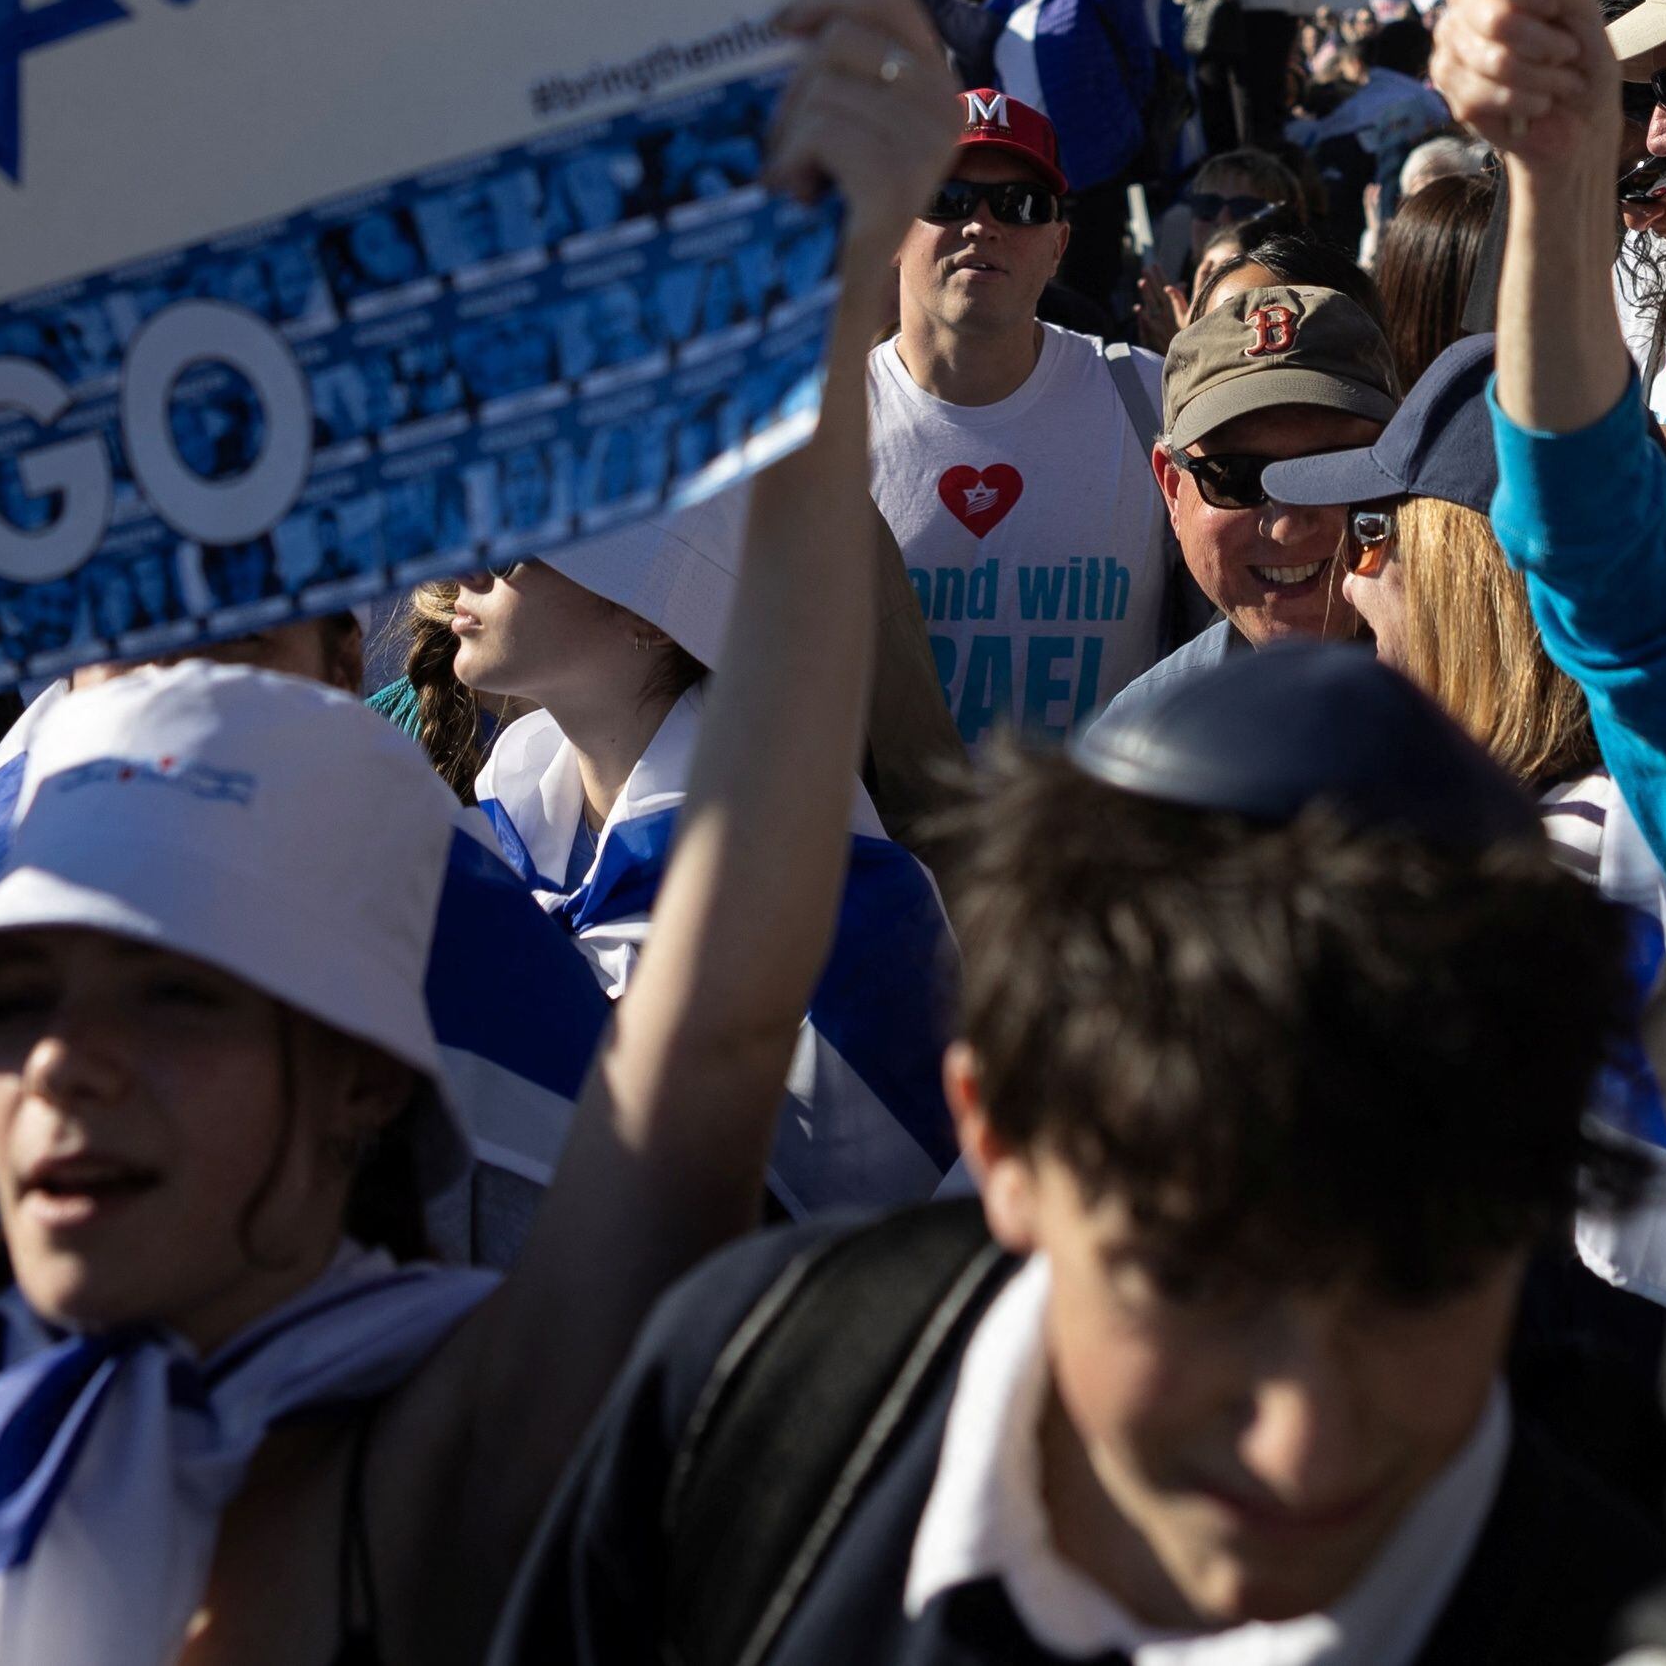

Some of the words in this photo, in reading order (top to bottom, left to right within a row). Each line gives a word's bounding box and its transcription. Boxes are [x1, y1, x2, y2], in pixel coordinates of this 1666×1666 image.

[964, 93, 1011, 128] M
[1244, 306, 1297, 356] B
[908, 557, 1000, 620] and
[1017, 556, 1131, 621] with
